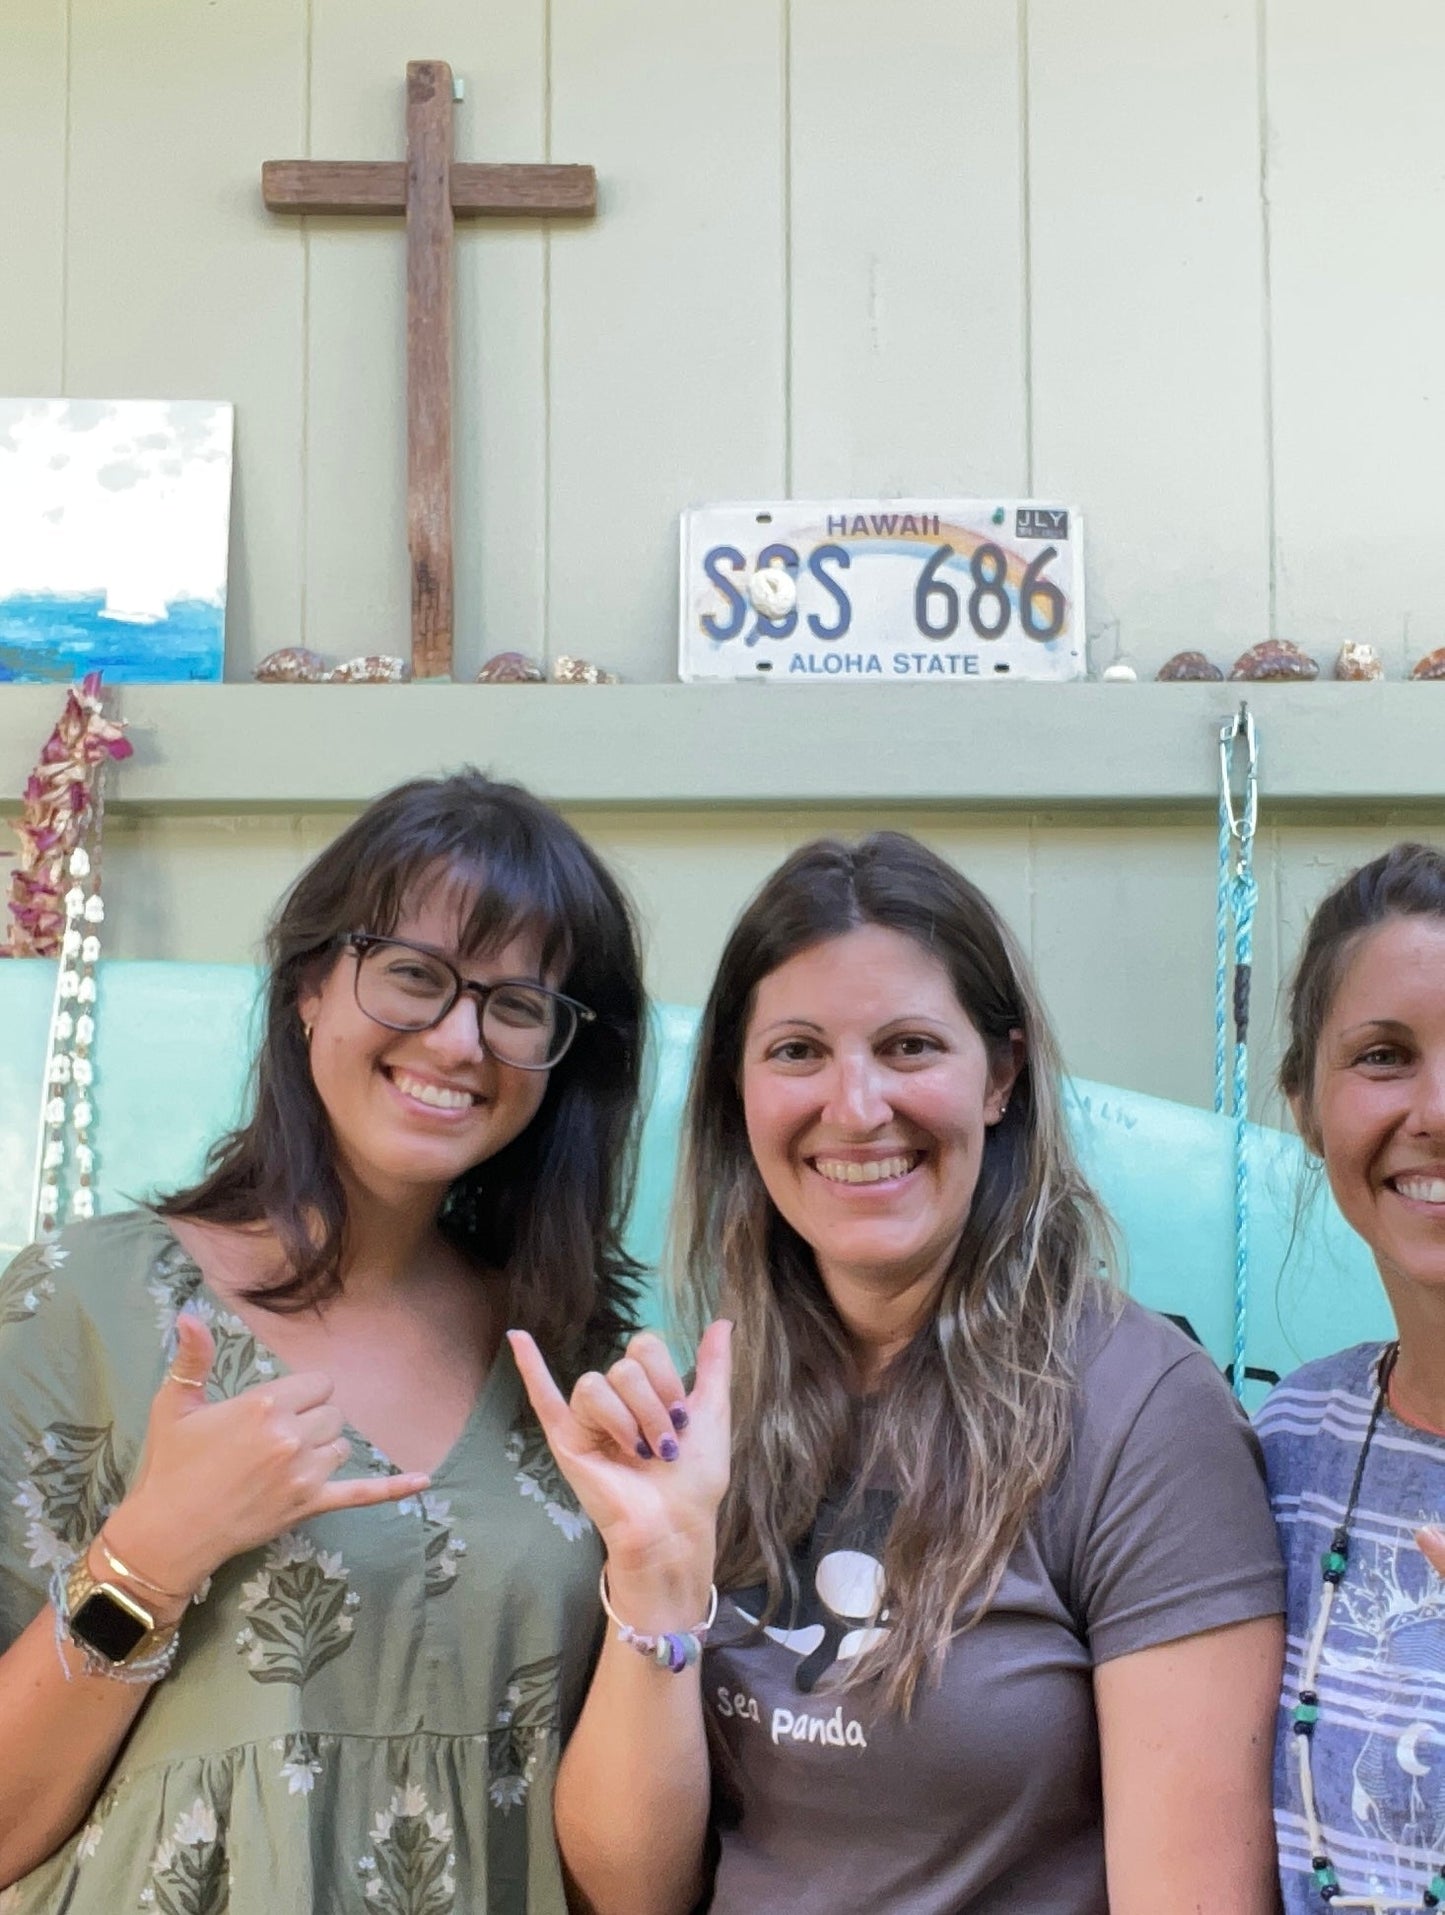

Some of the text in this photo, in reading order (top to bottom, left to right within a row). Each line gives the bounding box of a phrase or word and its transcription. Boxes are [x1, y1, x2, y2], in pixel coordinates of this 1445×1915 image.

[827, 514, 940, 536] HAWAII
[1018, 511, 1064, 528] JLY
[915, 543, 1066, 642] 686
[788, 653, 980, 675] ALOHA STATE
[717, 1686, 868, 1748] sea panda
